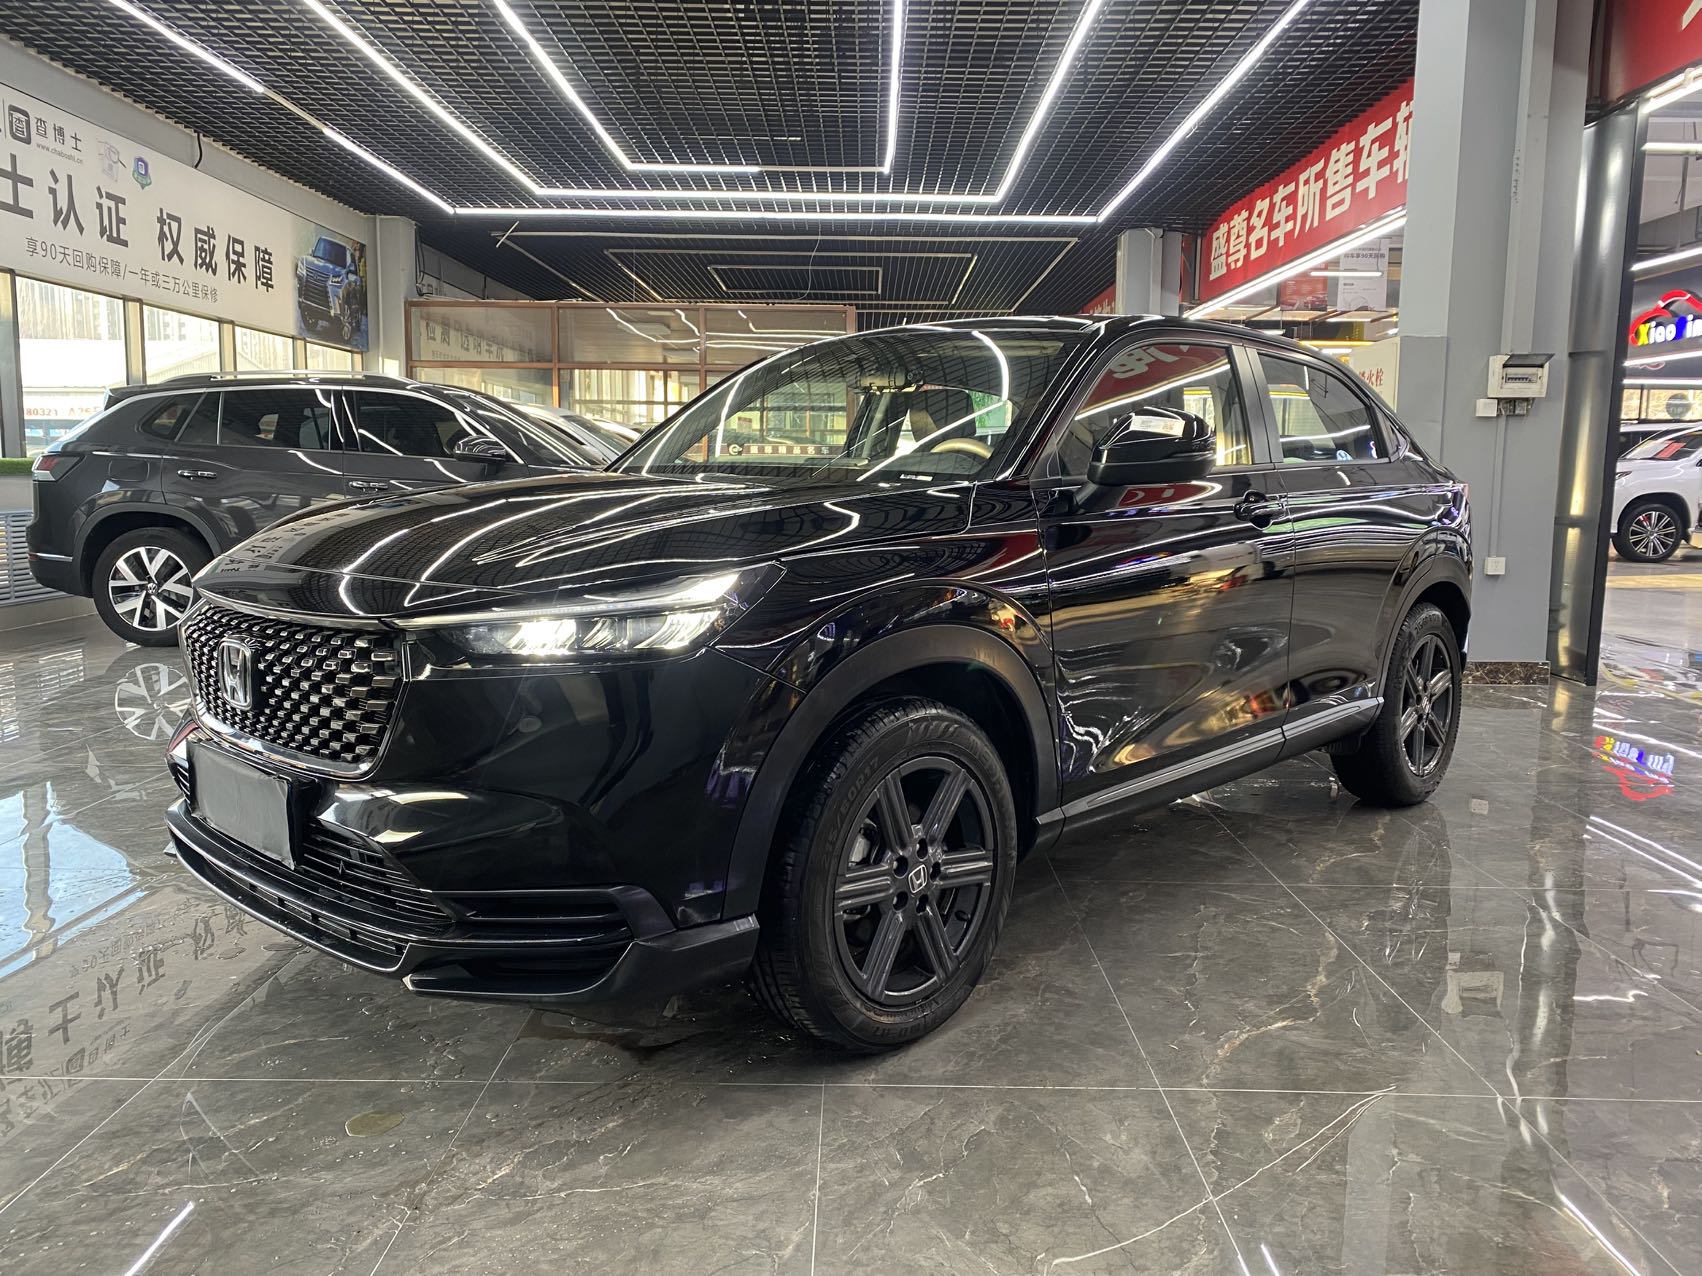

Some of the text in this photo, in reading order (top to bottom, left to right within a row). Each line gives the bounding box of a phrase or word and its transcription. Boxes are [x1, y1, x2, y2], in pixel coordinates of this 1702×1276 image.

[34, 117, 82, 153] 查博士
[25, 236, 218, 304] 享90天回购保障/一年或三万公里保修
[156, 207, 275, 293] 权威保障
